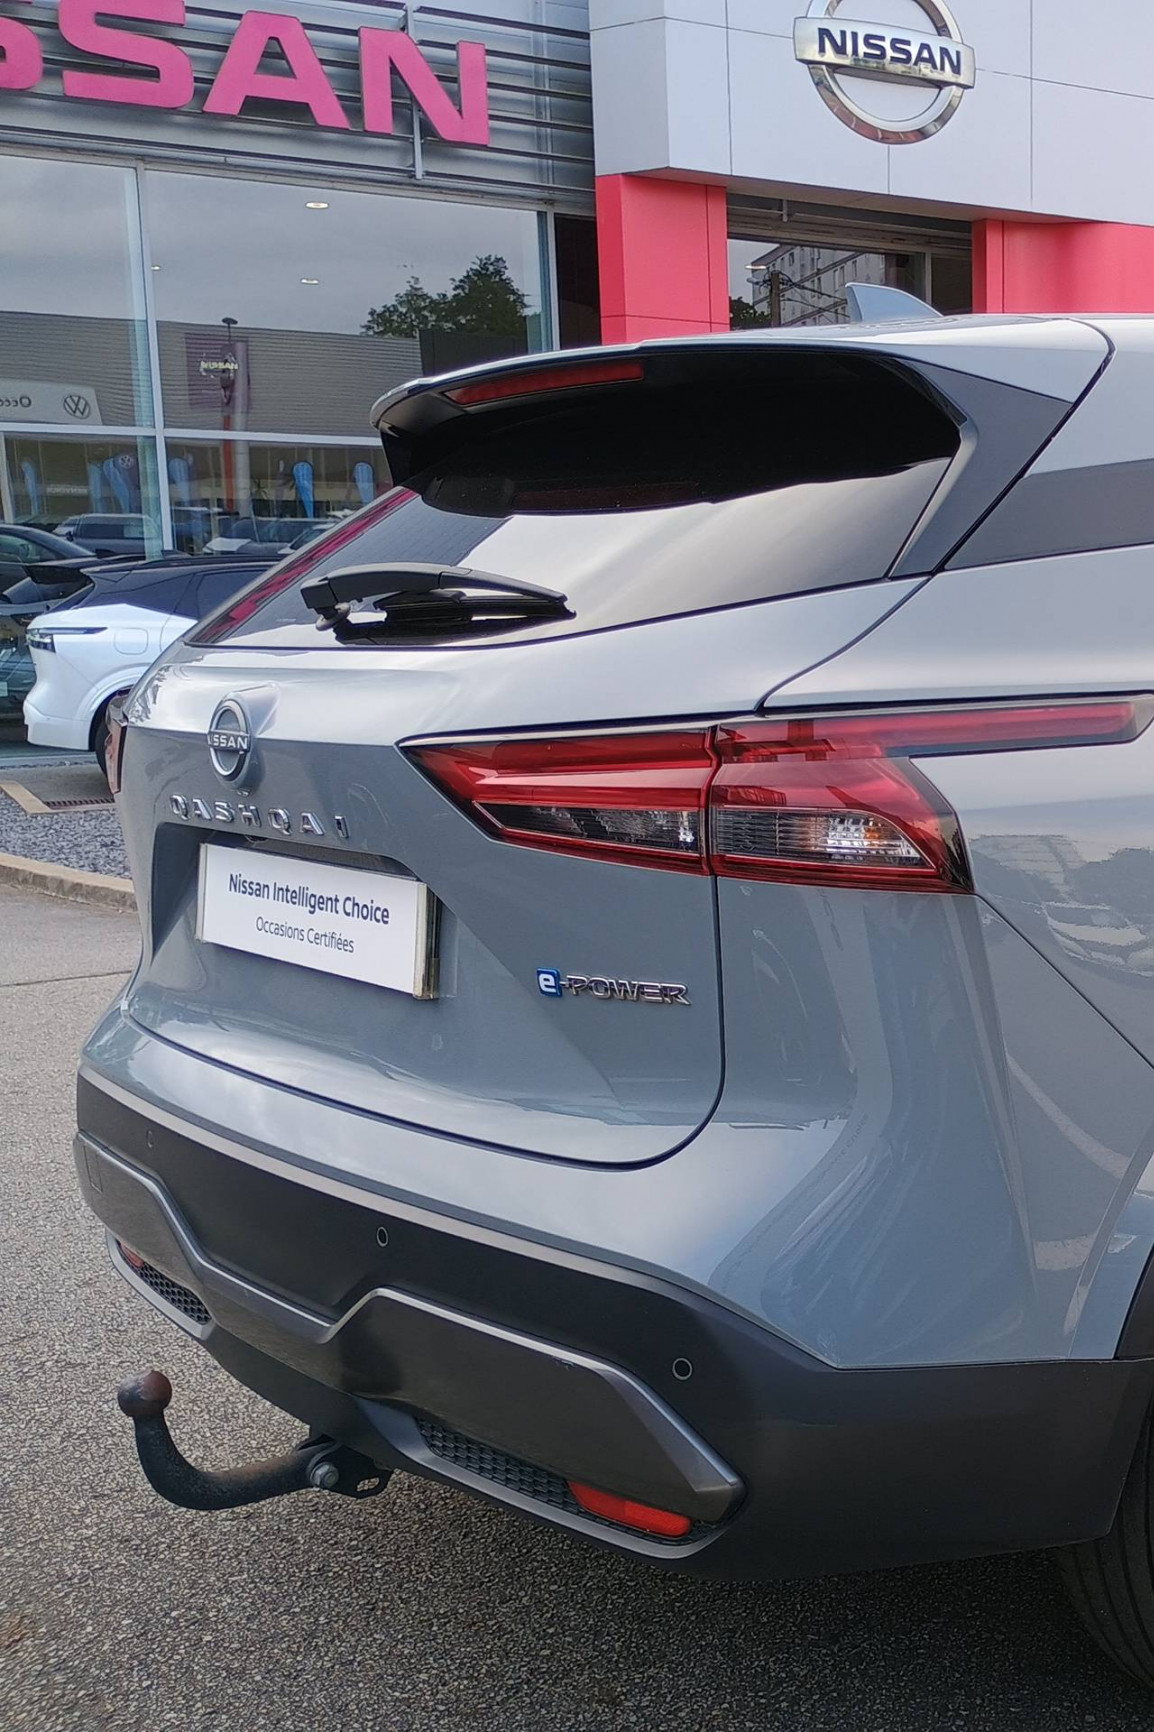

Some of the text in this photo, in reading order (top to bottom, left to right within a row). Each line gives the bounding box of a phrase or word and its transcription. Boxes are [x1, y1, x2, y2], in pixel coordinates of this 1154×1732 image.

[817, 27, 961, 76] NISSAN
[169, 794, 350, 839] QASHQAI
[228, 873, 390, 925] Nissan Intelligent Choice
[256, 916, 355, 954] Occasions Certifiées
